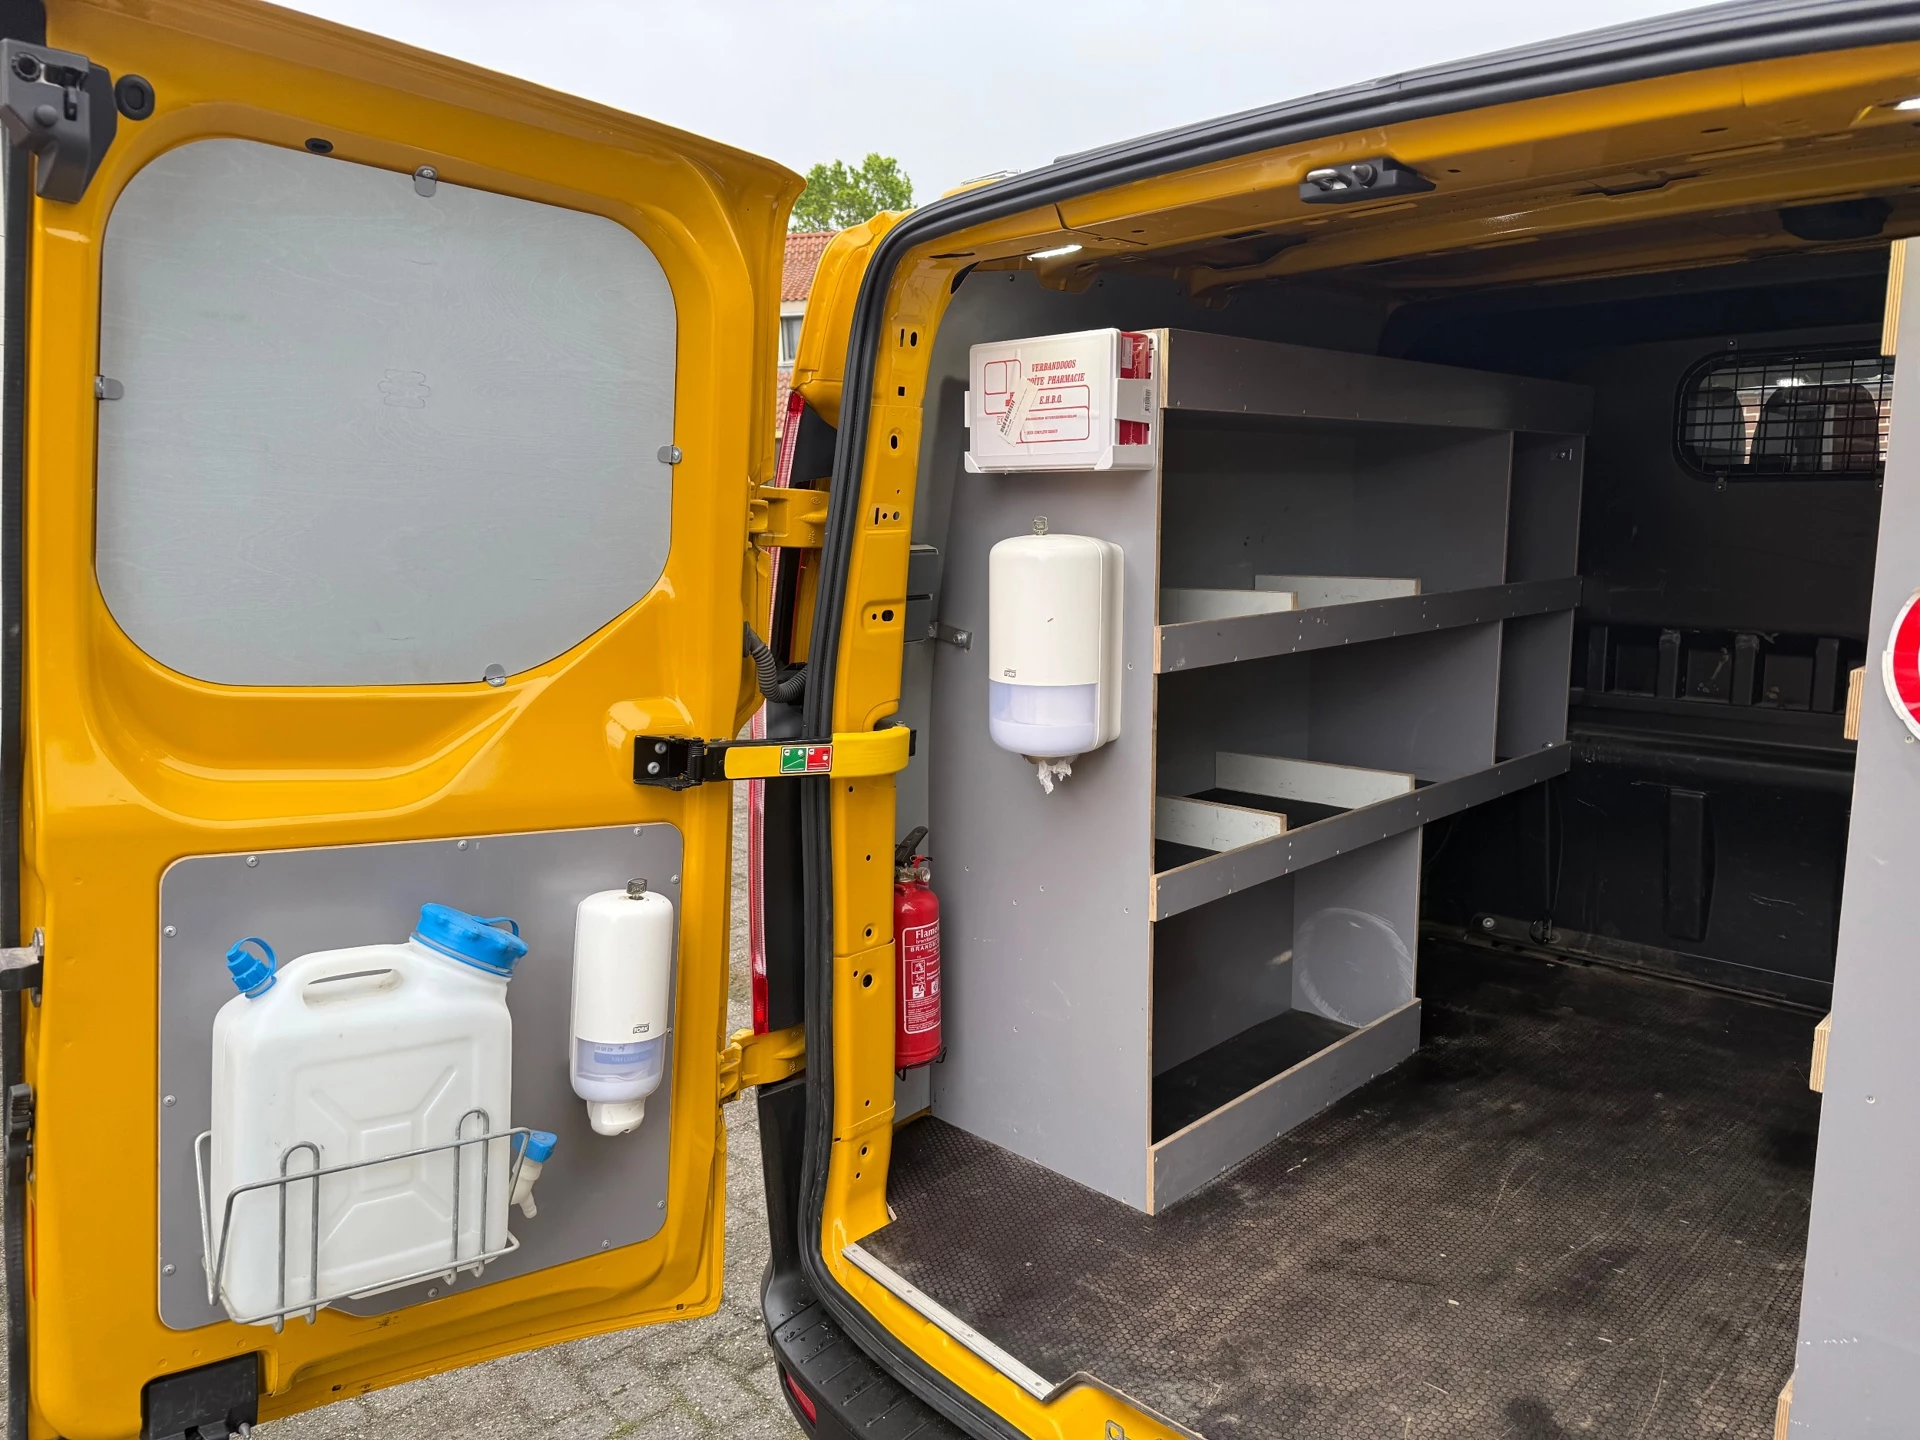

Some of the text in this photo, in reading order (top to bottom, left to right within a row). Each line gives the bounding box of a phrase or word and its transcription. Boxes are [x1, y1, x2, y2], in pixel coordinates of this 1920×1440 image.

[1032, 359, 1076, 372] VERBANDDOOS
[1047, 372, 1085, 385] PHARMACIE
[633, 1025, 650, 1034] TORK
